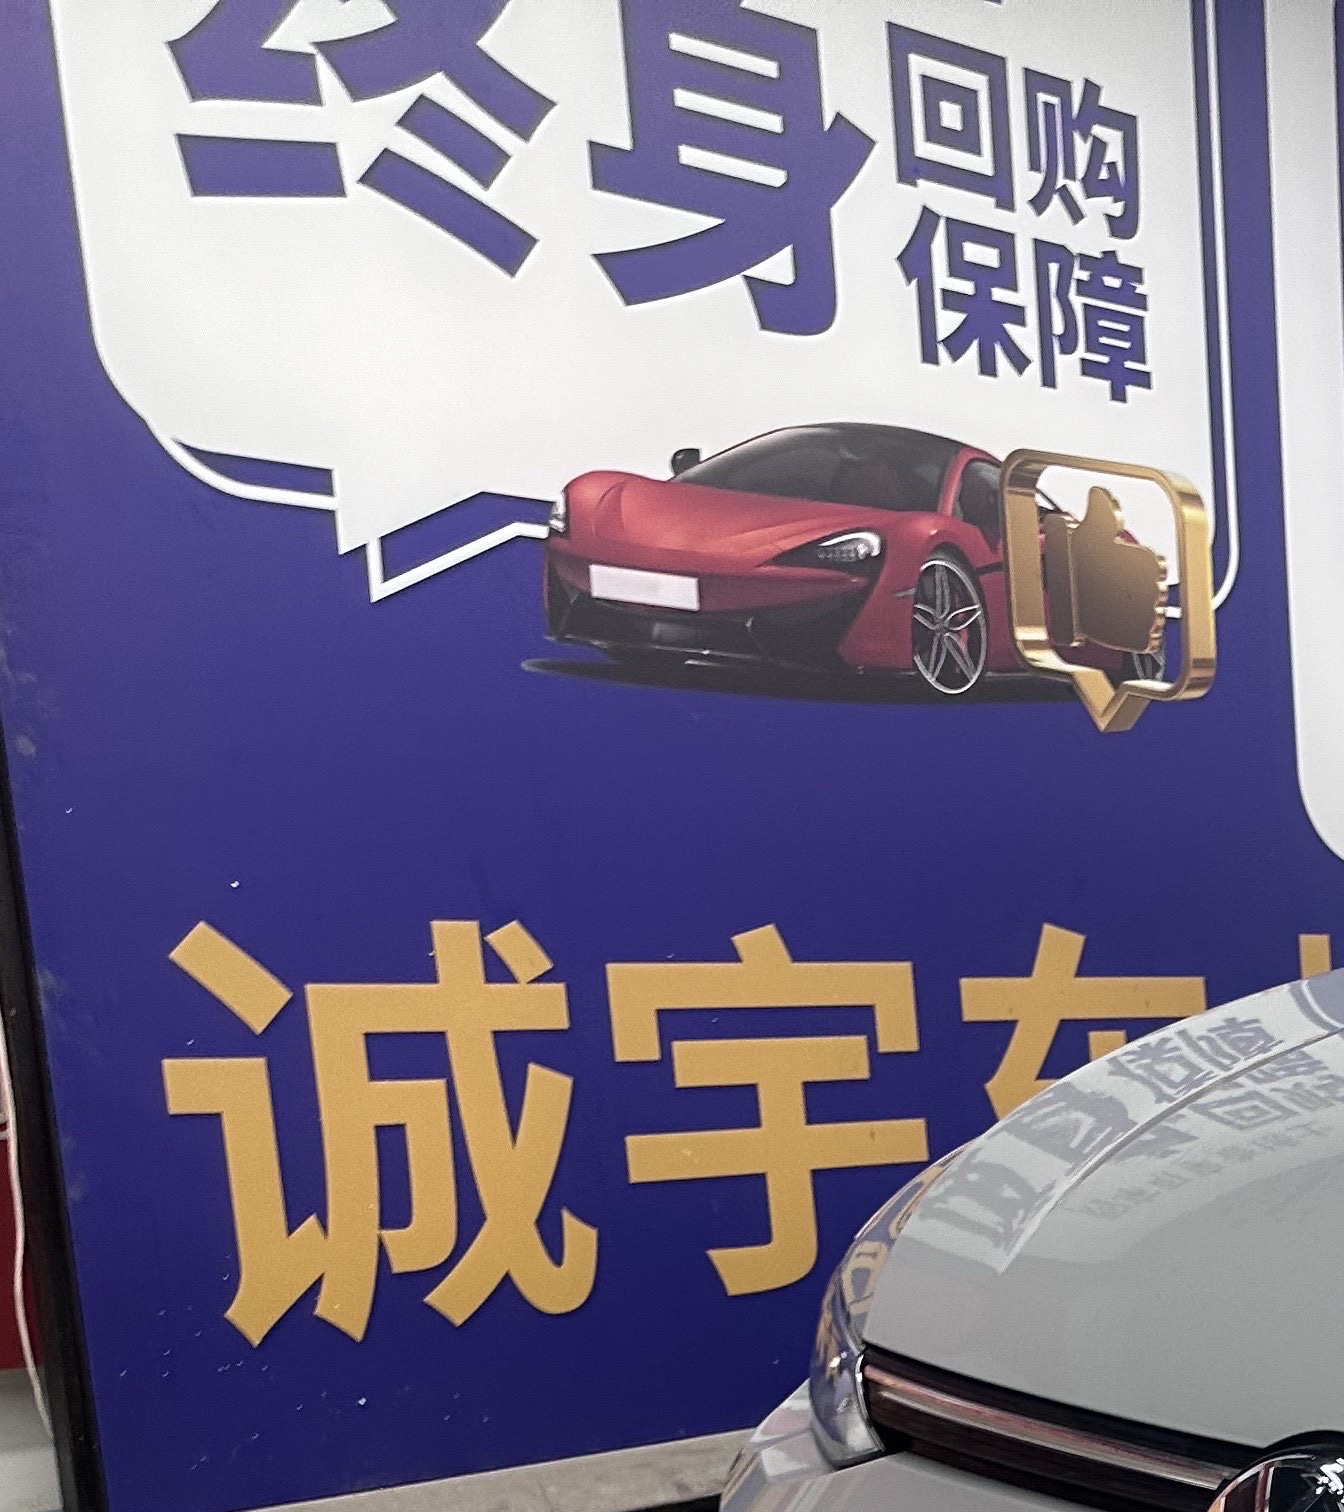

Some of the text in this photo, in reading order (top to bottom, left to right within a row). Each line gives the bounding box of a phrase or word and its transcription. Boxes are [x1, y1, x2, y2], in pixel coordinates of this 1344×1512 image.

[166, 0, 876, 337] 终身
[885, 20, 1141, 242] 回购
[896, 204, 1156, 406] 保障
